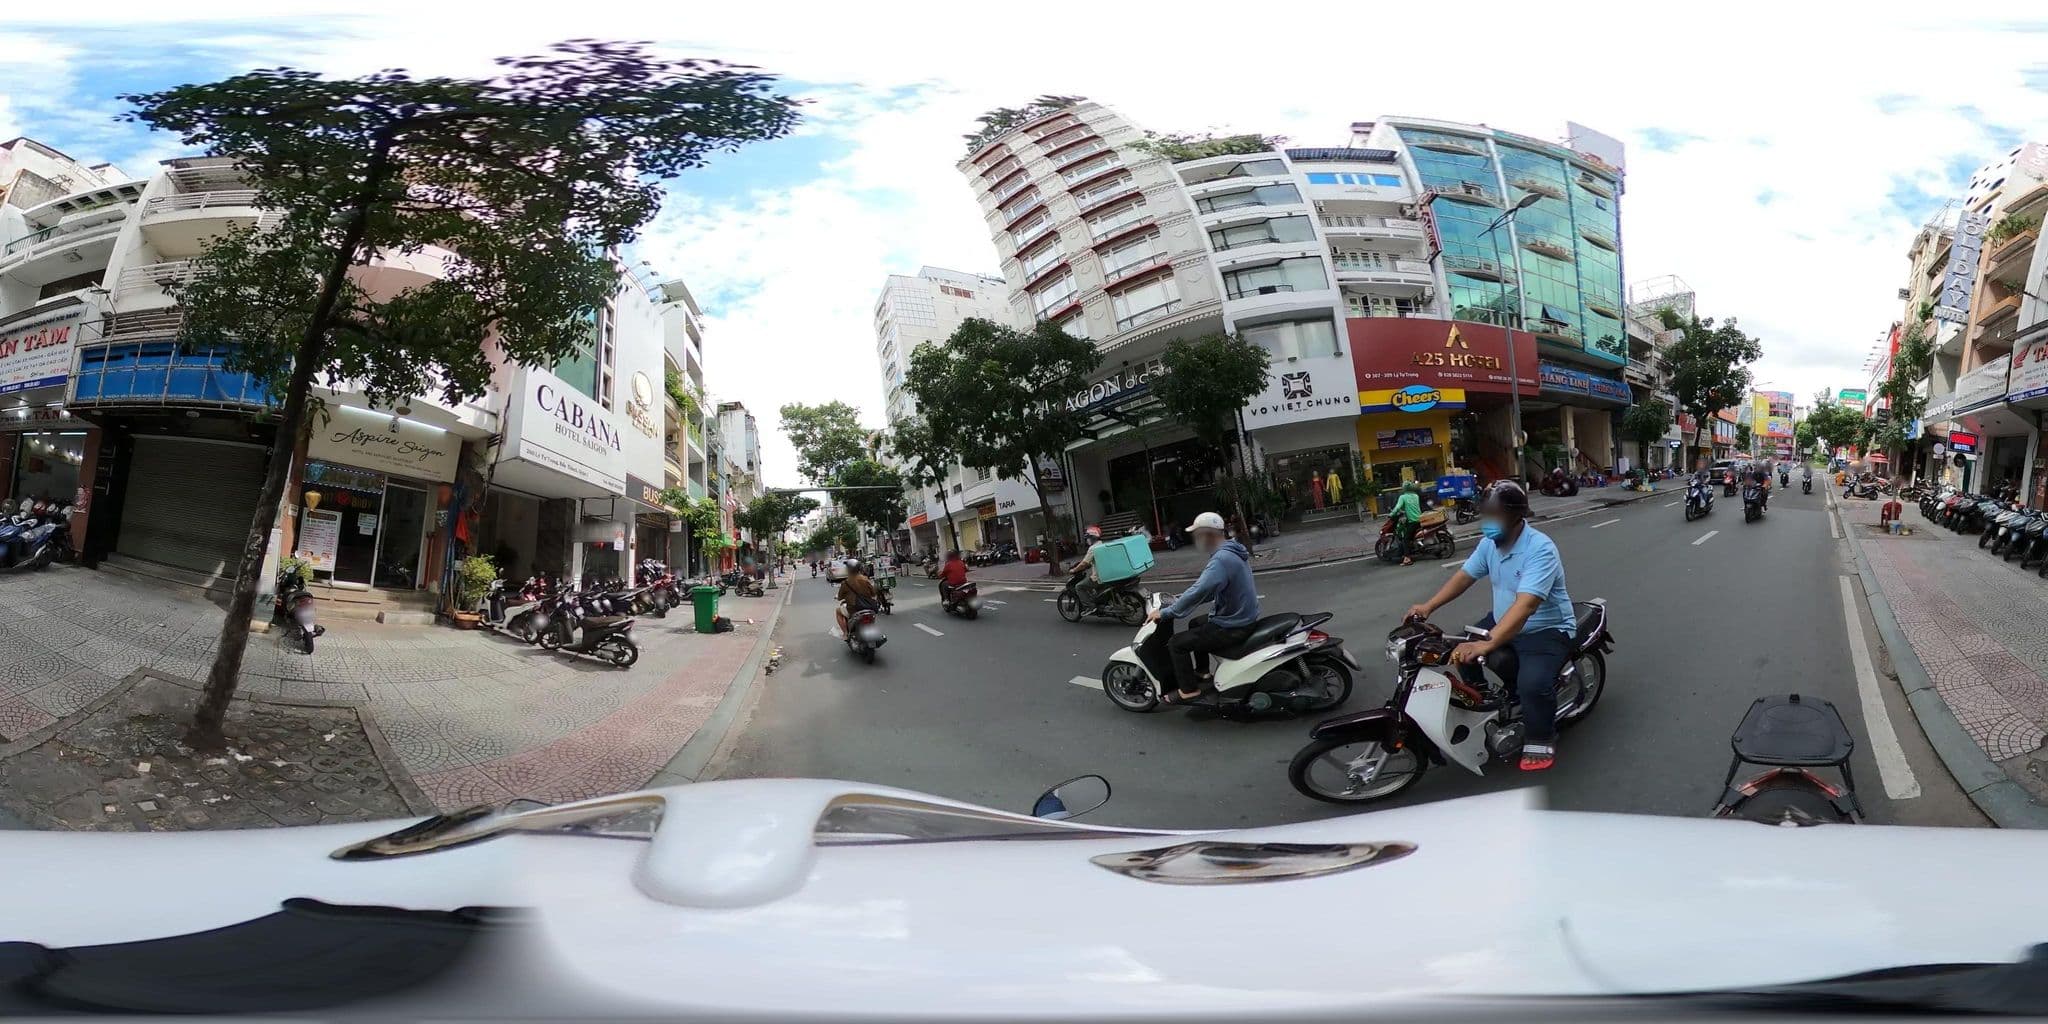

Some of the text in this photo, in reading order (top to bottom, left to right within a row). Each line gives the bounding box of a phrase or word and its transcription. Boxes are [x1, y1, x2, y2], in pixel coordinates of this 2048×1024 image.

[24, 326, 71, 352] TÂM
[1450, 352, 1502, 370] HOTEL
[1251, 396, 1351, 416] VO VIET CHUNG
[1392, 389, 1441, 408] Cheers
[537, 384, 621, 452] CABANA
[331, 428, 400, 447] Aspire
[398, 441, 446, 462] Saigon
[555, 424, 608, 456] HOTEL SAIGON
[998, 499, 1016, 510] TARA
